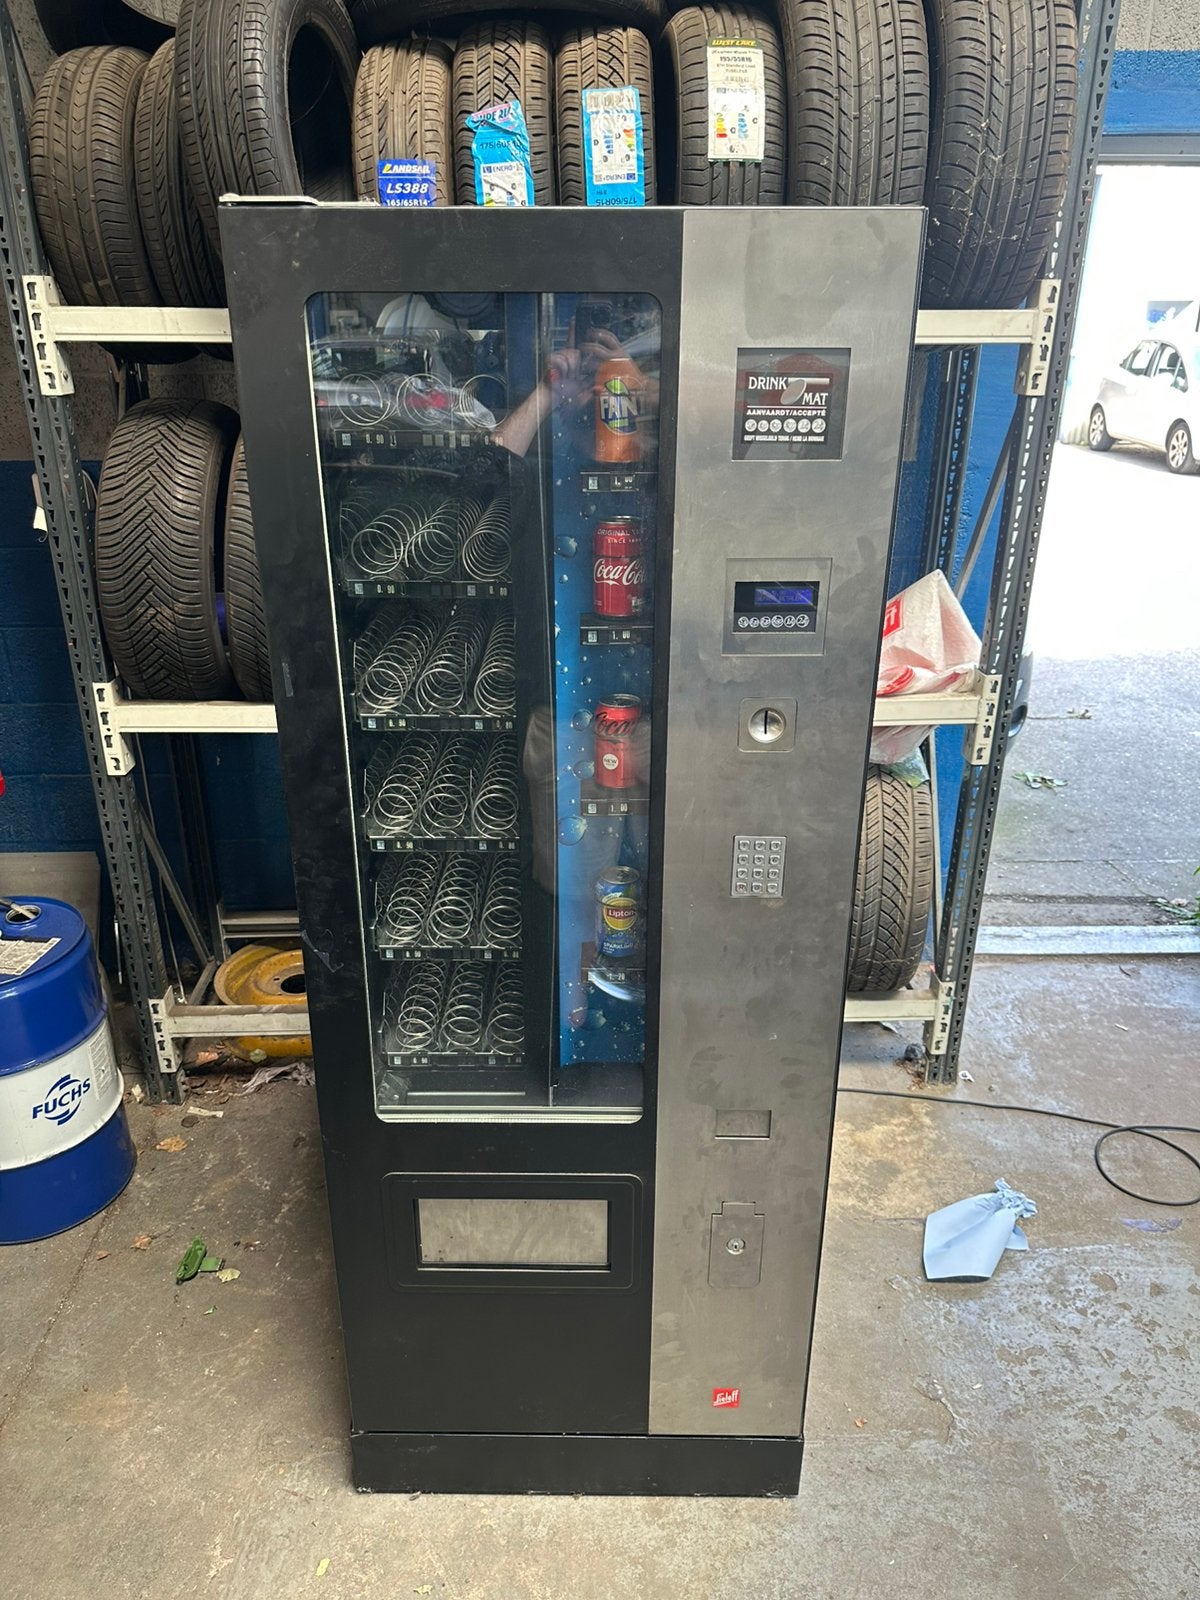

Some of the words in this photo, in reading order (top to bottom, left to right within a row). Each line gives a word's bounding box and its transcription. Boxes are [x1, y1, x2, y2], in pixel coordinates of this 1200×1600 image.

[382, 163, 431, 174] LANDSAIL
[386, 182, 429, 194] LS388
[748, 376, 788, 390] DRINK
[801, 392, 829, 406] MAT
[597, 528, 631, 537] ORIGINAL
[608, 909, 634, 918] Lipton
[32, 1078, 91, 1119] FUCHS
